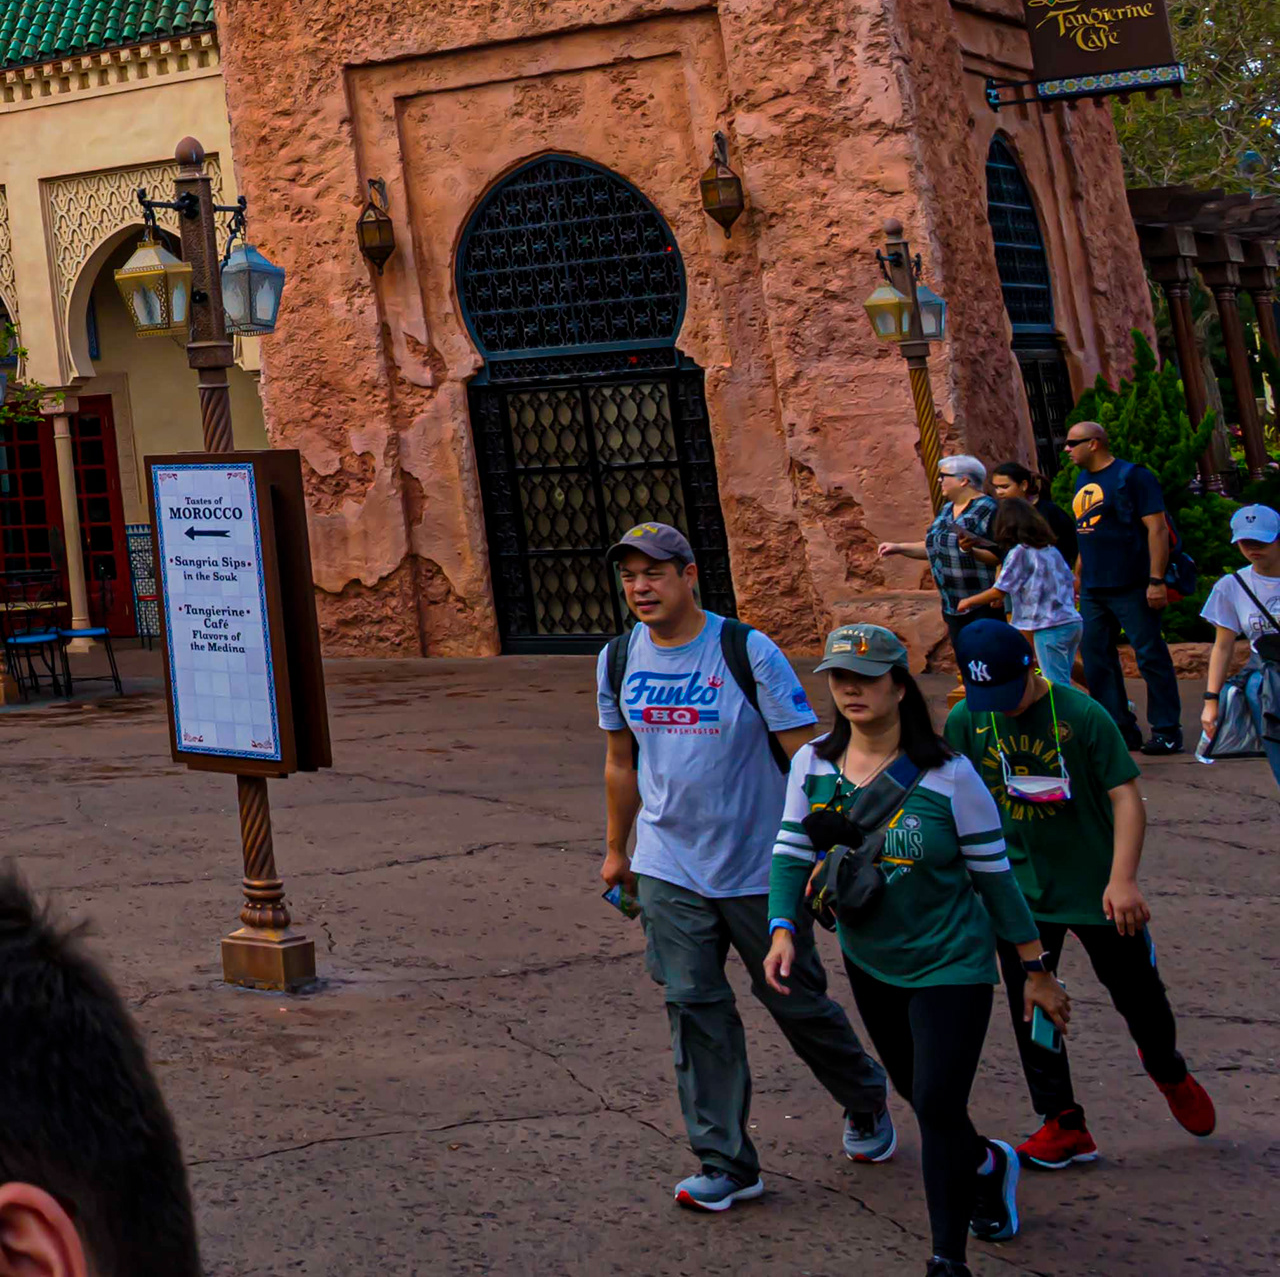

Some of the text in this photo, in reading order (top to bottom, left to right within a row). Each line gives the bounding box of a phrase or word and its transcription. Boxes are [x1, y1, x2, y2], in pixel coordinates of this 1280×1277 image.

[1035, 3, 1156, 37] Tangierine
[185, 496, 223, 505] Tastes of
[169, 507, 243, 520] MOROCCO
[175, 556, 246, 569] Sangria Sips
[183, 571, 238, 581] in the Souk
[184, 604, 245, 617] Tangierine
[204, 618, 229, 629] Café
[192, 630, 241, 641] Flavors of
[190, 641, 245, 653] the Medina
[625, 671, 719, 705] Funko
[650, 710, 692, 723] HQ
